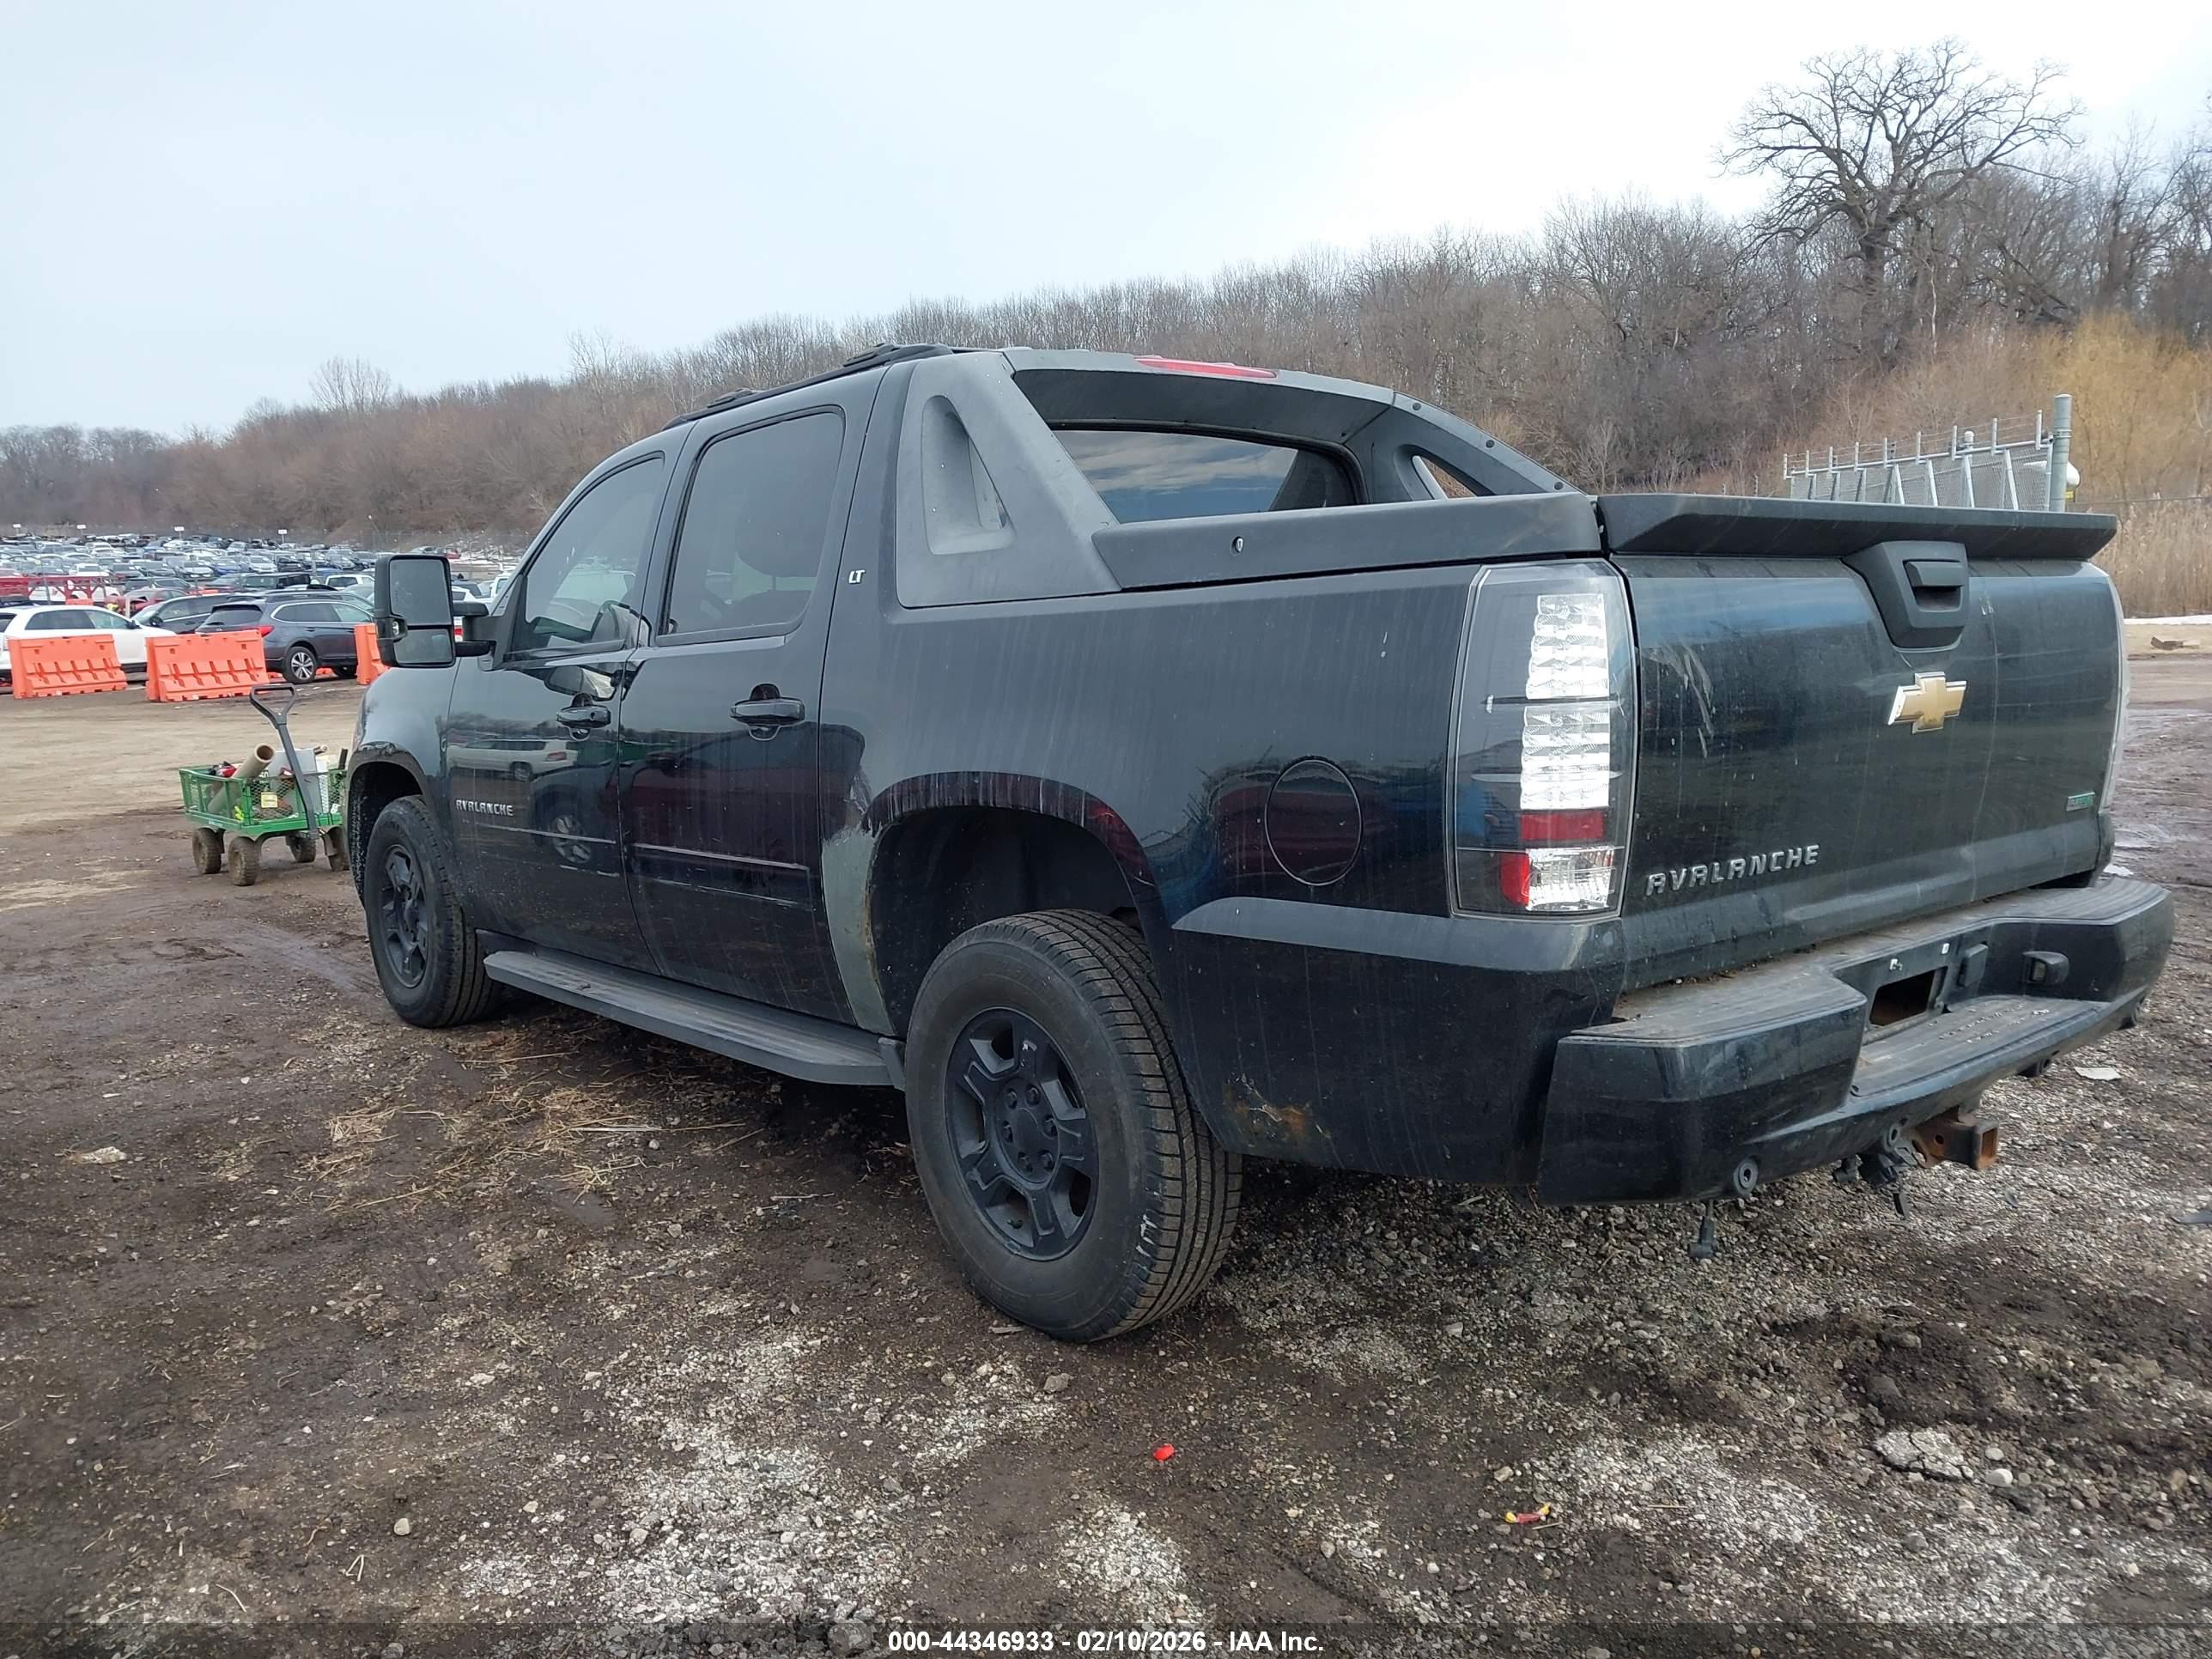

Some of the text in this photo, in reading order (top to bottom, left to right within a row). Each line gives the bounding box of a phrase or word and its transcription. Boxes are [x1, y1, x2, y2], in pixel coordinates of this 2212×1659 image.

[848, 569, 866, 584] LT
[456, 799, 514, 816] AVALANCHE
[1645, 844, 1820, 896] AVALANCHE
